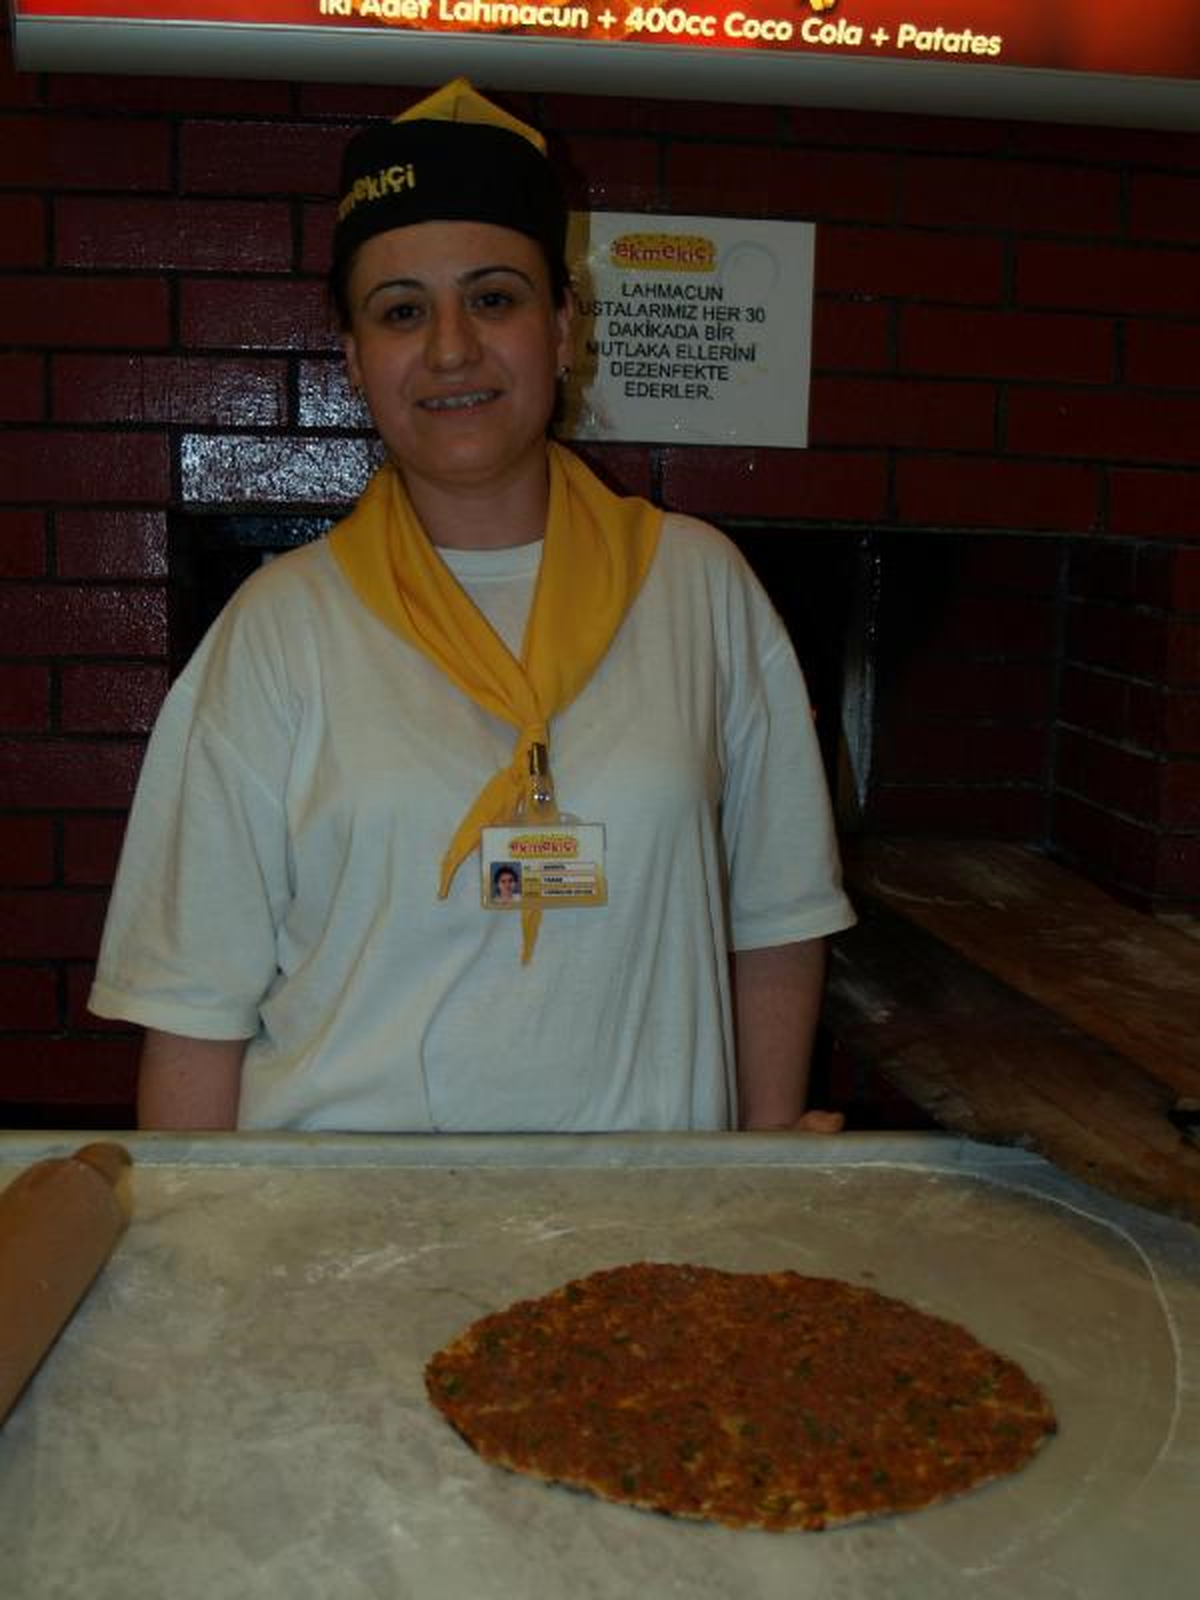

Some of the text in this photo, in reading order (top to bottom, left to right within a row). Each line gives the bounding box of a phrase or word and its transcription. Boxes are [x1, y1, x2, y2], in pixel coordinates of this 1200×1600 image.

[360, 0, 432, 20] Adet
[439, 0, 589, 28] Lahmacun
[597, 12, 617, 29] +
[624, 7, 716, 36] 400cc
[723, 12, 793, 41] Coco
[801, 17, 863, 46] Cola
[870, 25, 889, 47] +
[896, 23, 1002, 56] Patates
[621, 283, 724, 301] LAHMACUN
[578, 301, 766, 323] USTALARIMIZ HER 30
[608, 320, 735, 341] DAKİKADA BİR
[586, 341, 756, 362] MUTLAKA ELLERİNİ
[610, 361, 729, 381] DEZENFEKTE
[624, 381, 715, 400] EDERLER.
